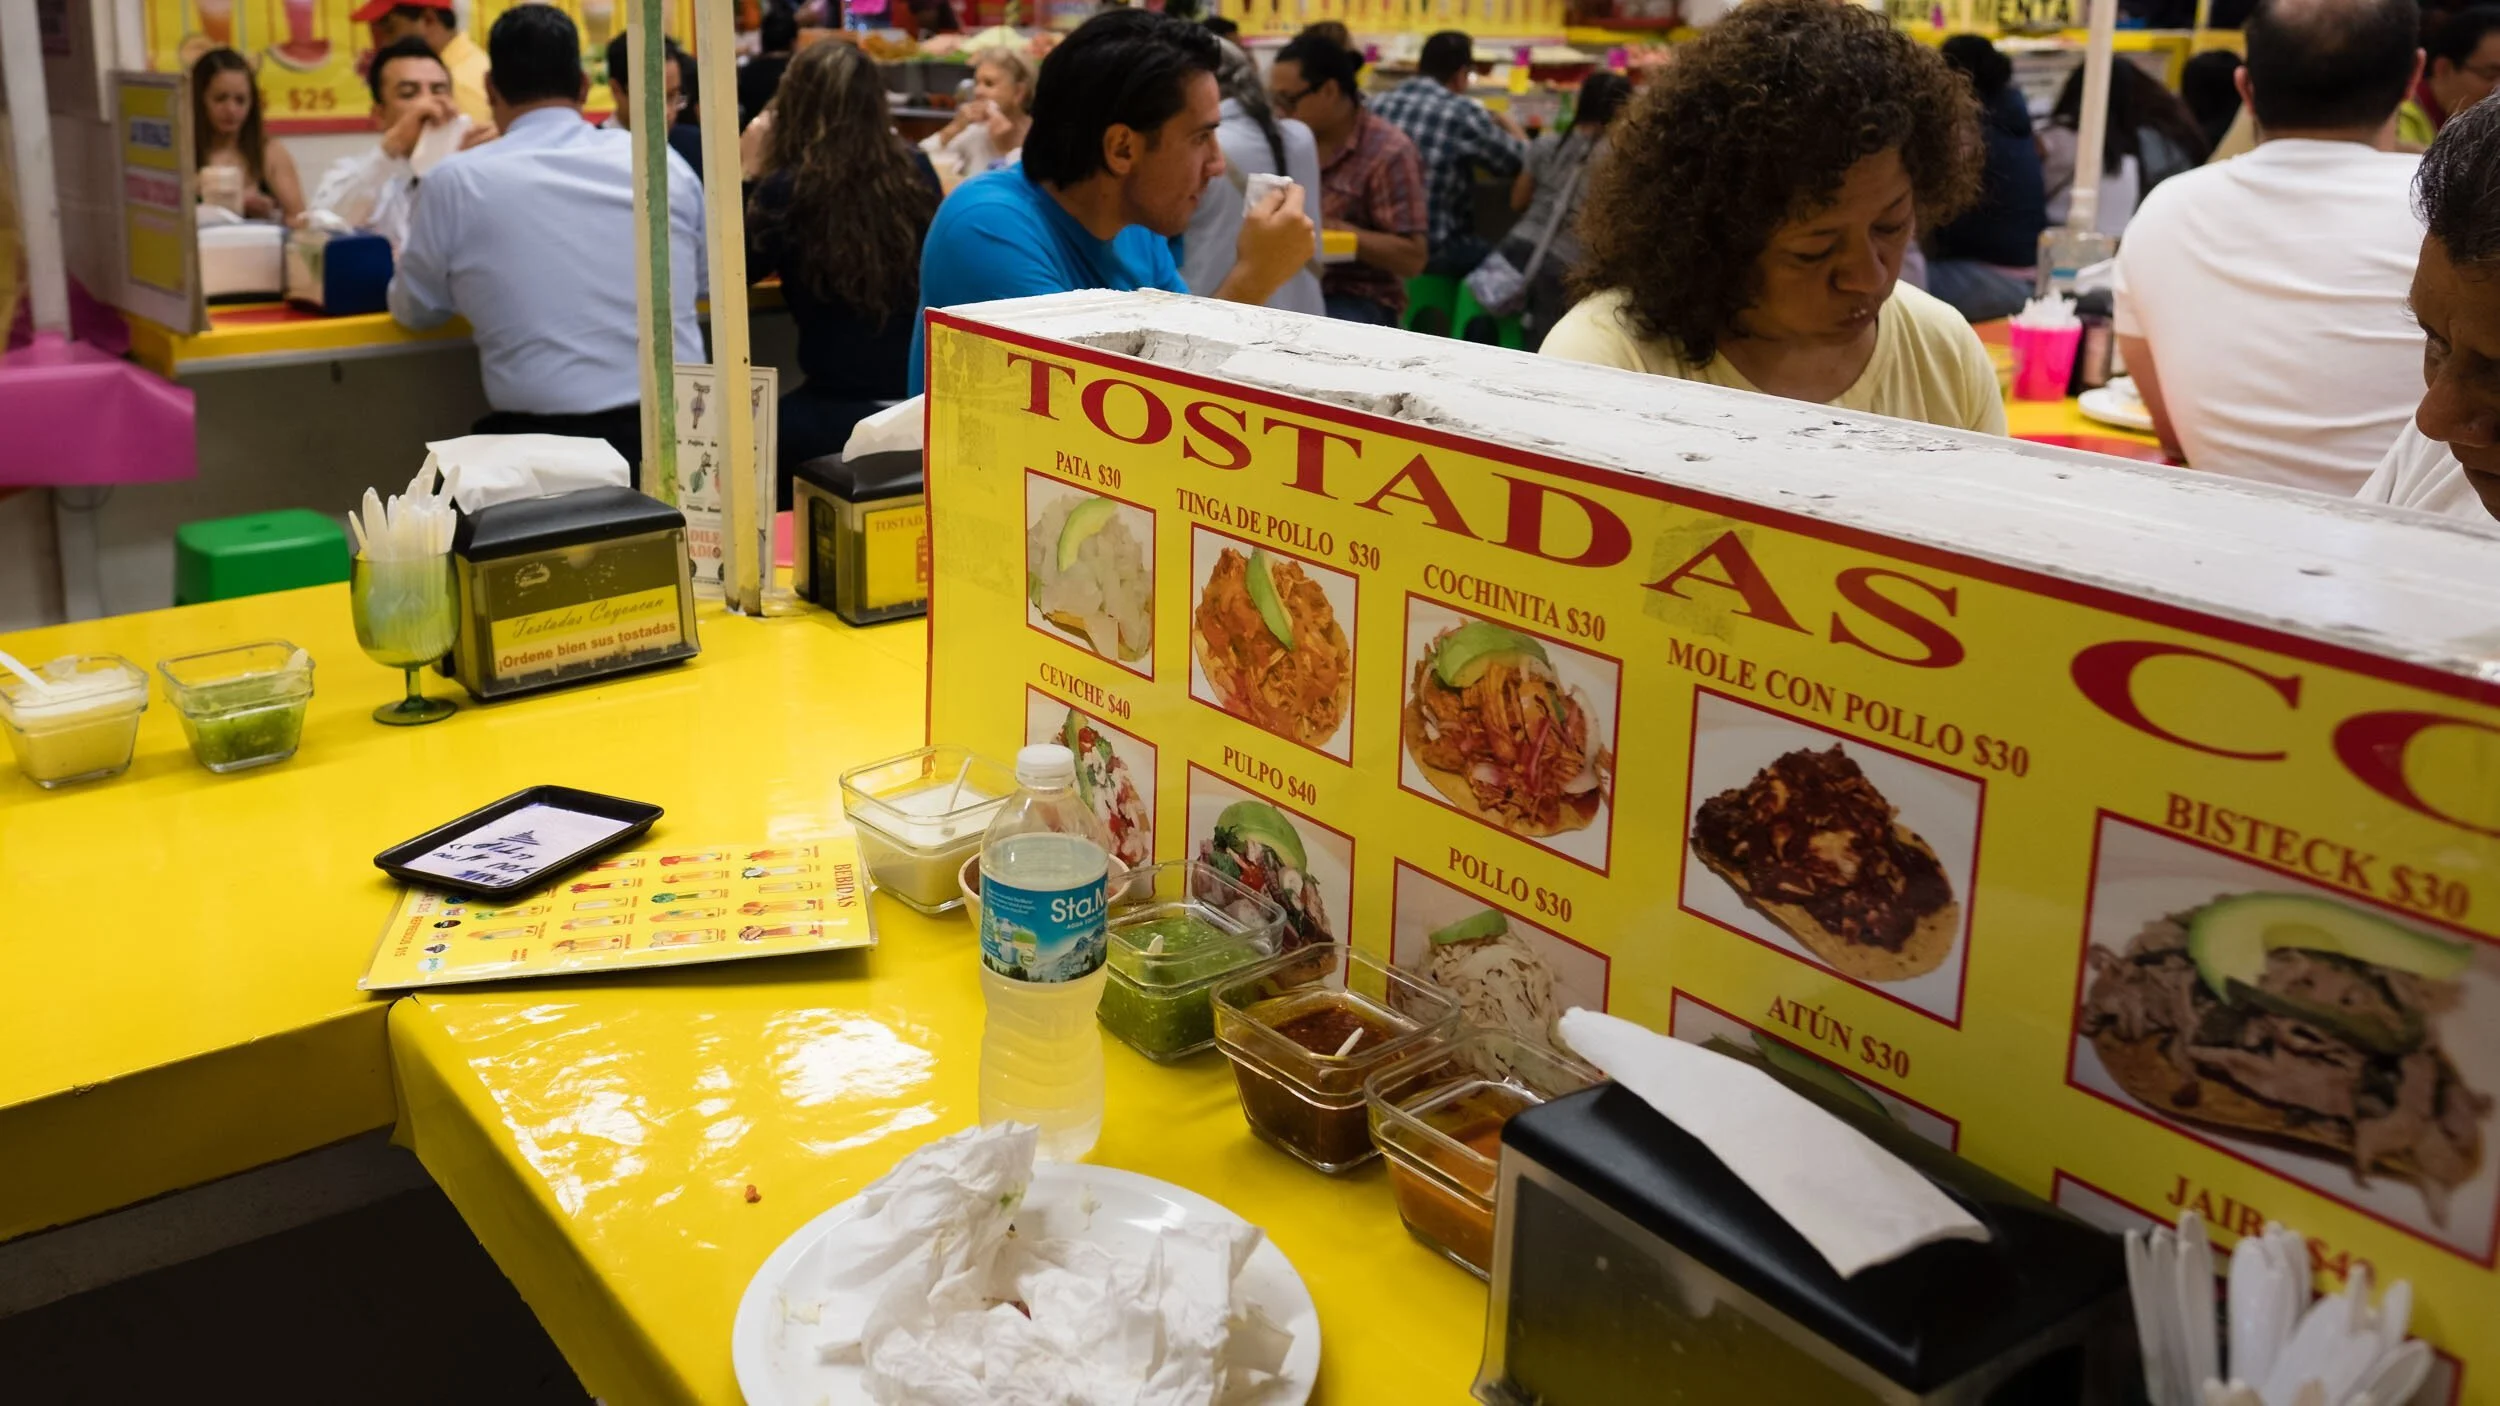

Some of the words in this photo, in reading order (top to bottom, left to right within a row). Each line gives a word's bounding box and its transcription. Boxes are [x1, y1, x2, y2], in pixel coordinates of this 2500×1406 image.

[288, 88, 336, 113] $25
[1056, 450, 1092, 481] PATA
[1098, 463, 1121, 490] $30
[875, 514, 926, 532] TOSTAD
[1007, 352, 1966, 669] TOSTADAS
[1176, 487, 1232, 526] TINGA
[1236, 506, 1262, 534] DE
[1266, 515, 1333, 556] POLLO
[1349, 540, 1380, 571] $30
[513, 608, 583, 638] Tostadas
[1423, 564, 1561, 629] COCHINITA
[1566, 607, 1606, 642] $30
[499, 649, 554, 672] ¡Ordene
[557, 641, 587, 657] bien
[591, 636, 614, 648] sus
[618, 622, 676, 643] tostadas
[1040, 662, 1104, 708] CEVICHE
[1108, 694, 1131, 720] $40
[1666, 638, 1757, 690] MOLE
[1765, 669, 1836, 715] CON
[1843, 692, 1964, 757] POLLO
[1972, 734, 2030, 778] $30
[1223, 745, 1283, 790] PULPO
[1288, 775, 1317, 806] $40
[834, 863, 858, 908] BEBIDAS
[1448, 846, 1529, 902] POLLO
[1535, 887, 1572, 923] $30
[2166, 792, 2379, 894] BISTECK
[2387, 863, 2471, 921] $30
[1766, 994, 1854, 1054] ATÚN
[1860, 1034, 1910, 1080] $30
